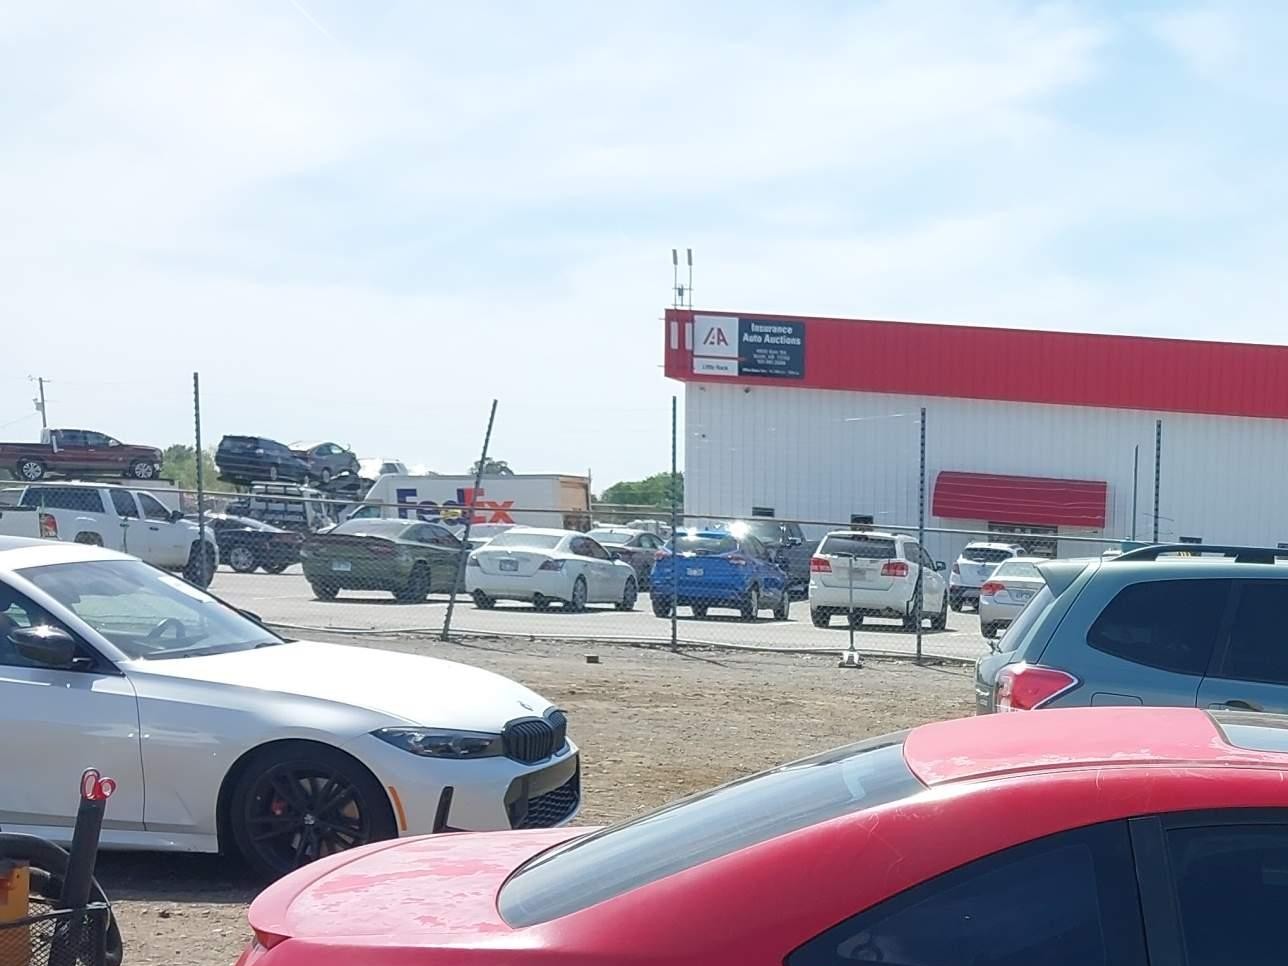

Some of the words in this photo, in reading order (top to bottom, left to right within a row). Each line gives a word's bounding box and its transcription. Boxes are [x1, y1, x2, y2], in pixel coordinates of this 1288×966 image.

[751, 322, 793, 334] Insurance
[743, 333, 763, 343] Auto
[764, 335, 801, 346] Auctions
[396, 487, 515, 526] FedEx
